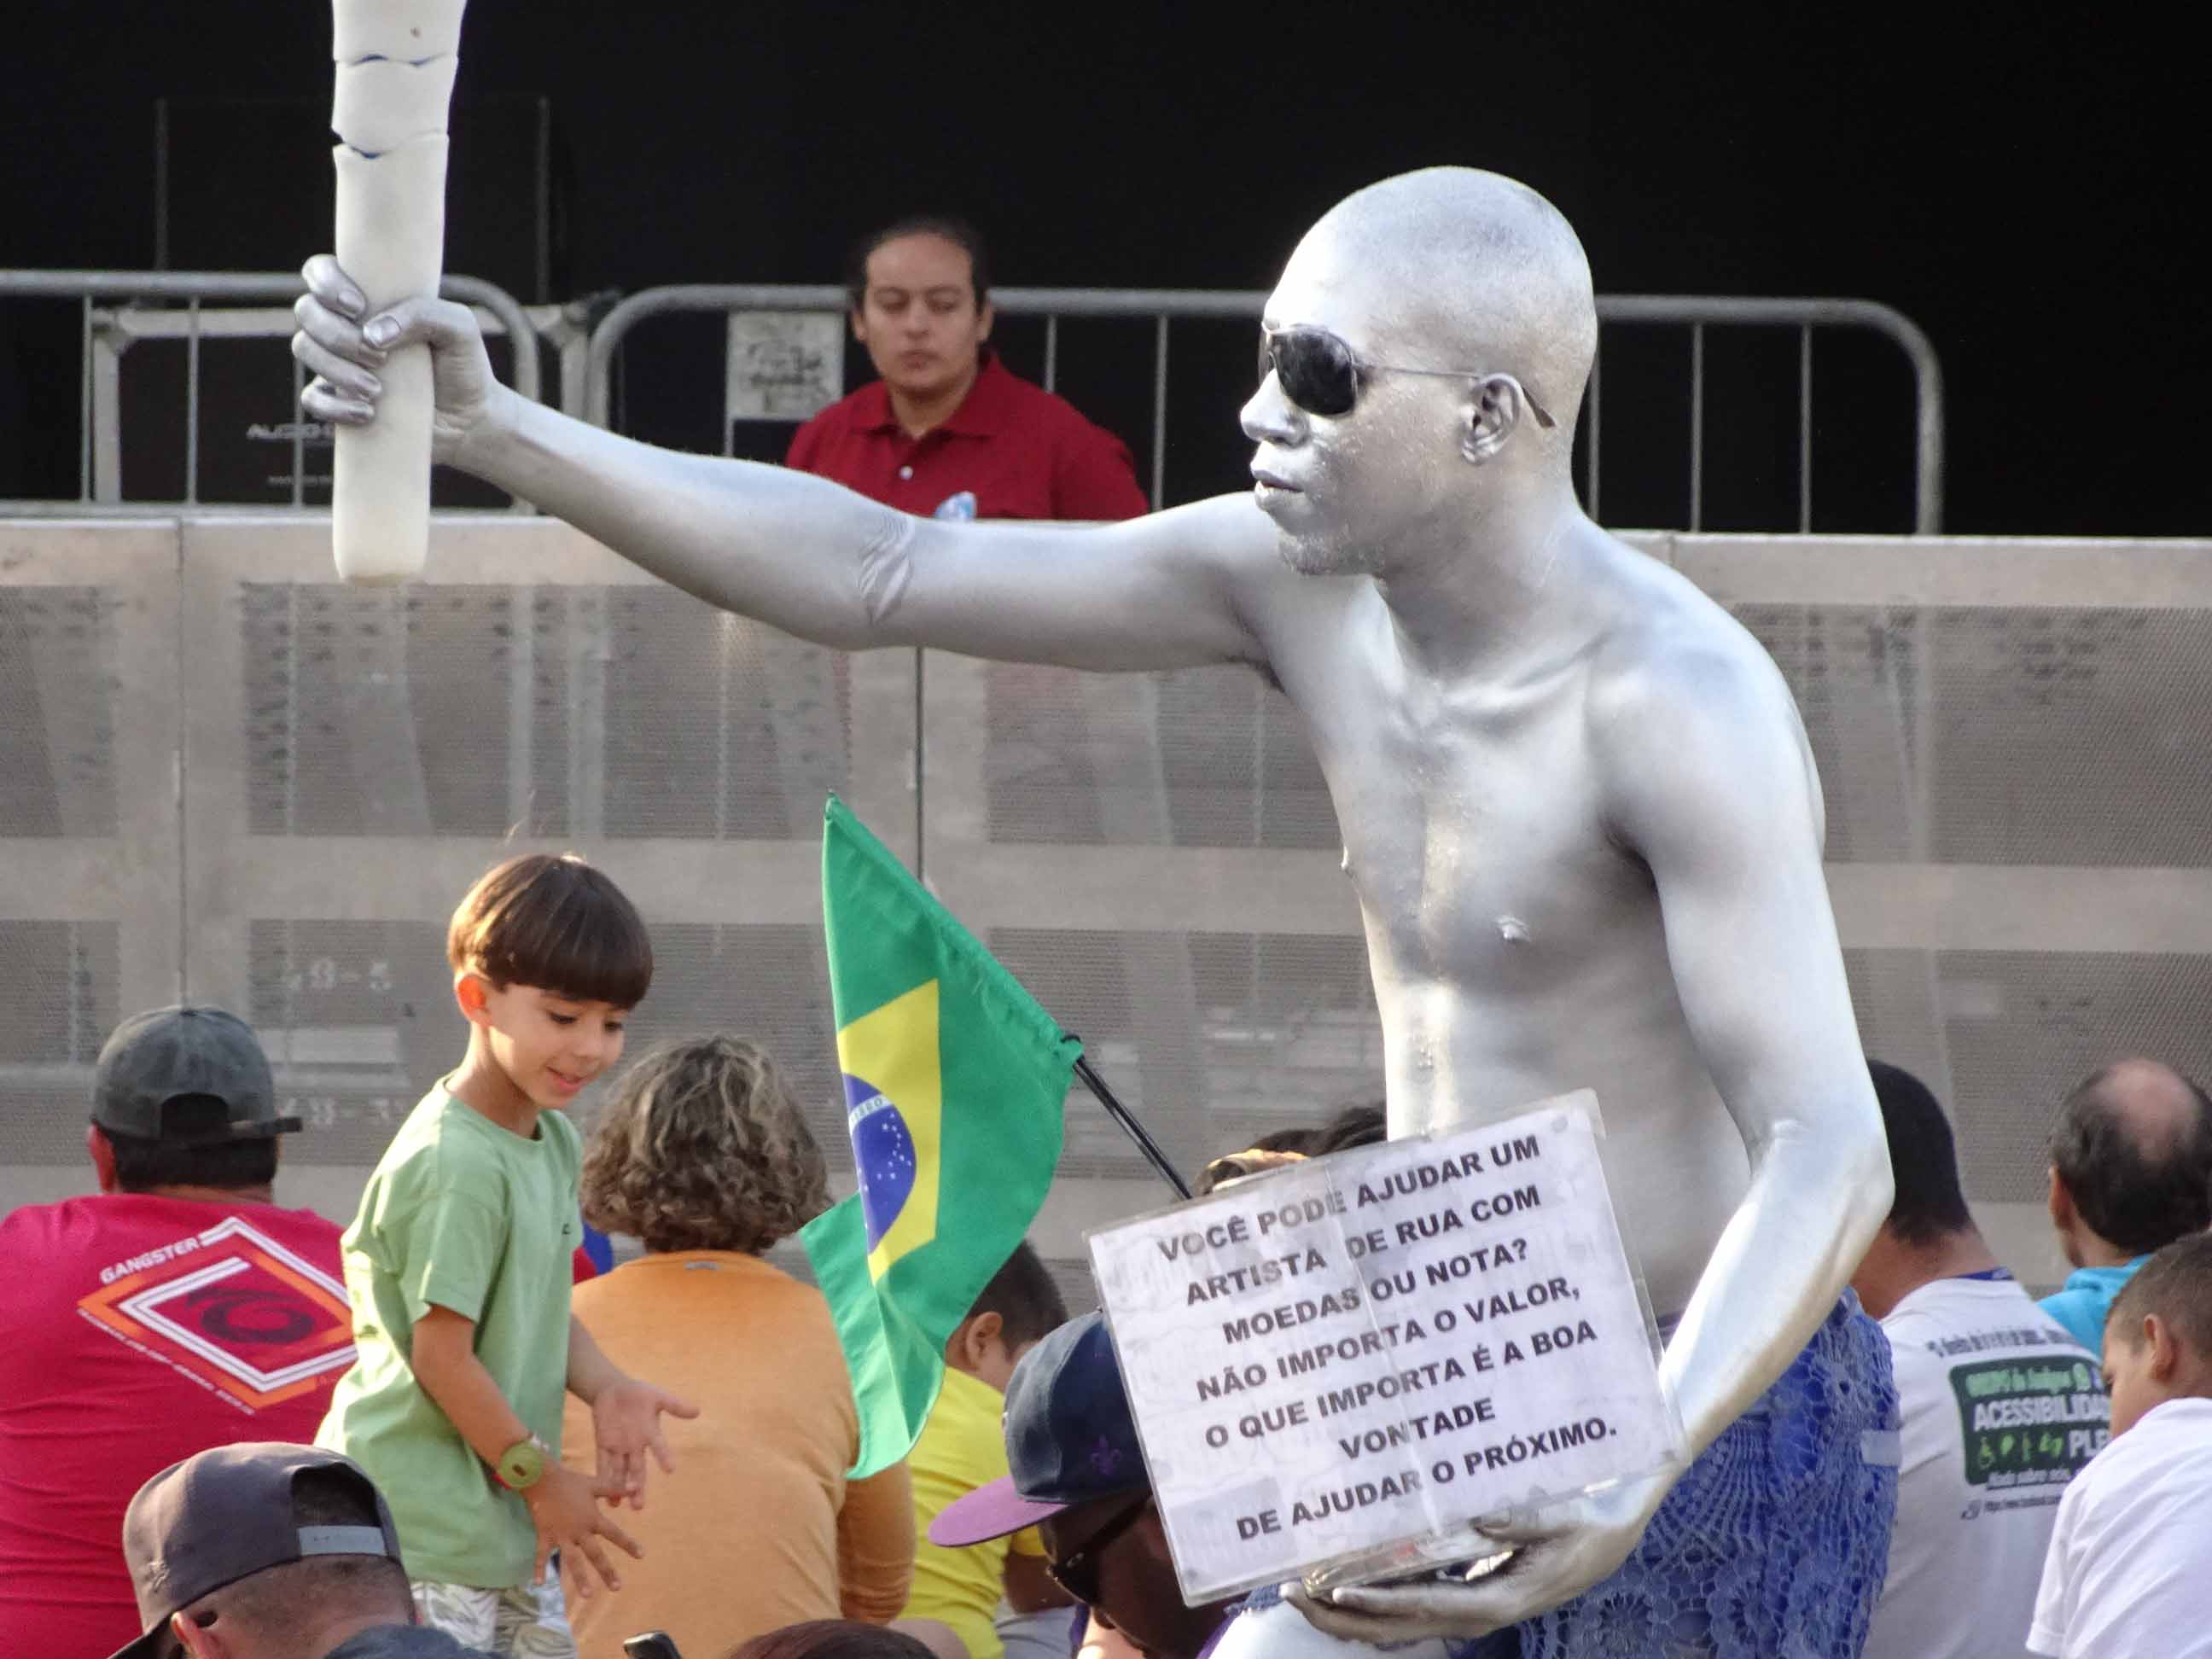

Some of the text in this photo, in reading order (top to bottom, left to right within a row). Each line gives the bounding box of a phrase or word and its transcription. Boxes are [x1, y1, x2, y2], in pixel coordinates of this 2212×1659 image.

[1157, 1133, 1541, 1262] VOCÊ PODE AJUDAR UM
[1186, 1185, 1541, 1306] ARTISTA DE RUA COM
[100, 1237, 201, 1284] GANGSTER
[1223, 1237, 1529, 1345] MOEDAS OU NOTA?
[1196, 1276, 1581, 1401] NÃO IMPORTA O VALOR,
[1205, 1318, 1598, 1450] O QUE IMPORTA É A BOA
[1339, 1397, 1496, 1461] VONTADE
[1974, 1394, 2111, 1431] ACESSIBILIDA
[2069, 1429, 2111, 1460] PLE
[1236, 1417, 1618, 1540] DE AJUDAR O PRÓXIMO.
